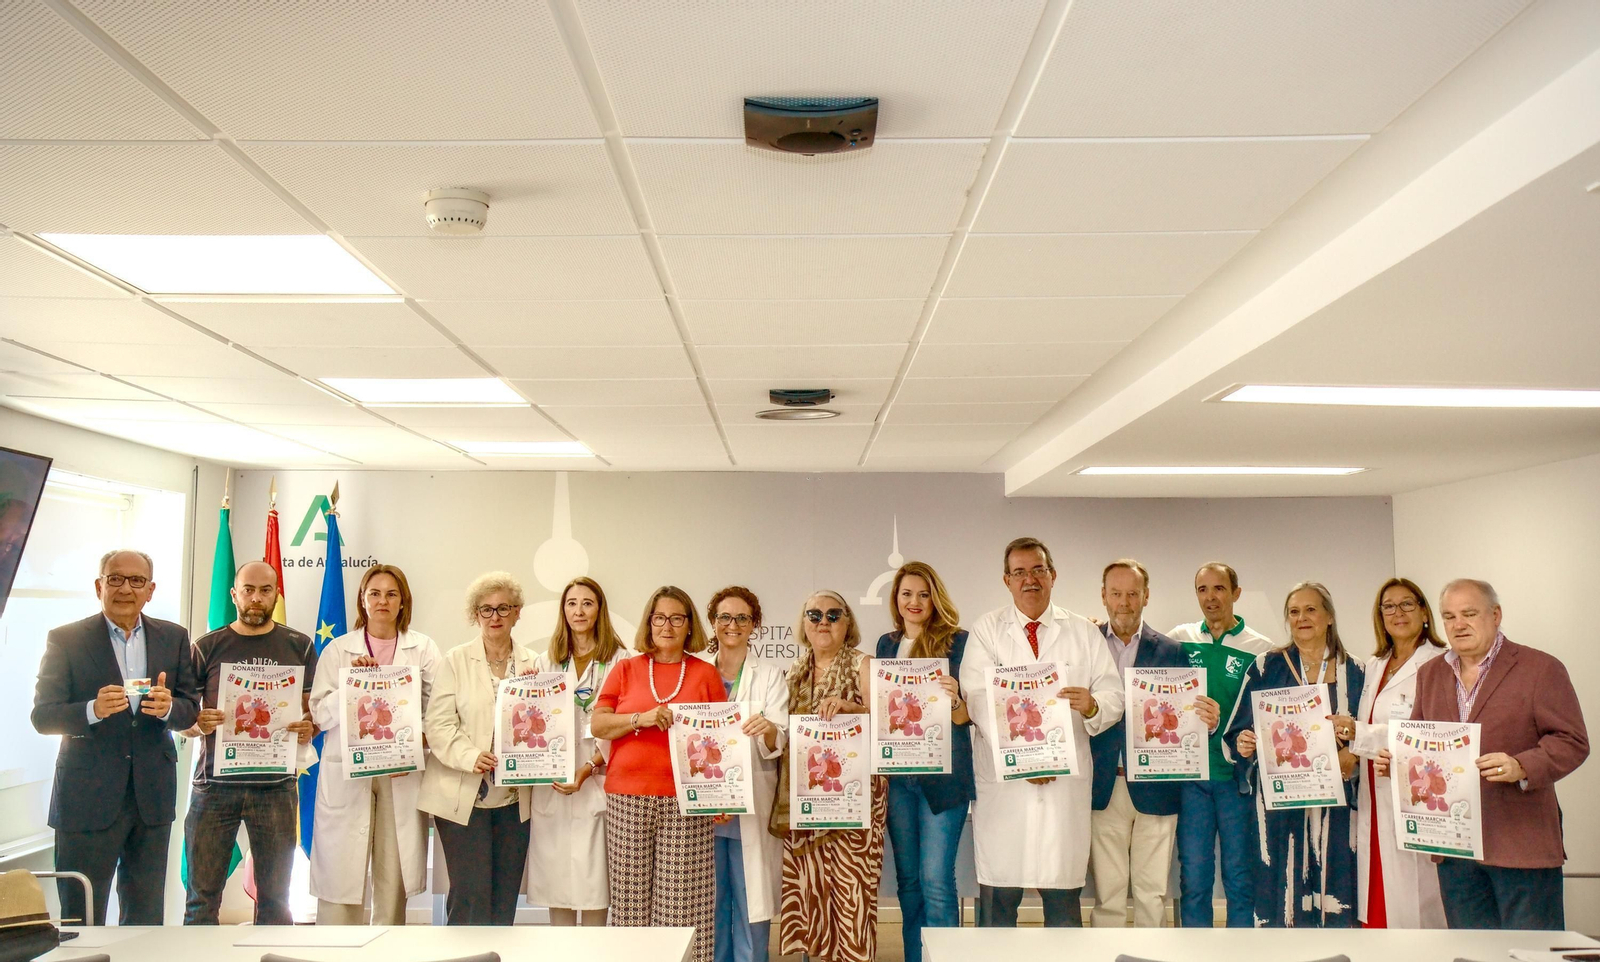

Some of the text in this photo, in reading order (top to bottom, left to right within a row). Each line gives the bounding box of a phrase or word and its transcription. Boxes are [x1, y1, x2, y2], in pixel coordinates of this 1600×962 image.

[298, 557, 313, 568] de
[316, 556, 378, 568] Aalucía
[910, 660, 940, 673] fronteras
[1026, 663, 1055, 678] fronteras
[262, 668, 294, 680] fronteras
[380, 667, 410, 679] fronteras
[1165, 670, 1196, 682] fronteras
[509, 676, 536, 684] DONANTES
[534, 674, 564, 687] fronteras
[1289, 686, 1318, 702] fronteras
[708, 704, 739, 717] fronteras
[830, 716, 860, 729] fronteras
[1433, 725, 1468, 738] fronteras
[228, 748, 234, 757] 8
[356, 753, 361, 761] 8
[885, 747, 890, 756] 8
[508, 760, 514, 768] 8
[1008, 755, 1013, 764] 8
[1141, 755, 1146, 763] 8
[1276, 781, 1281, 790] 8
[804, 803, 809, 811] 8
[1409, 821, 1415, 830] 8
